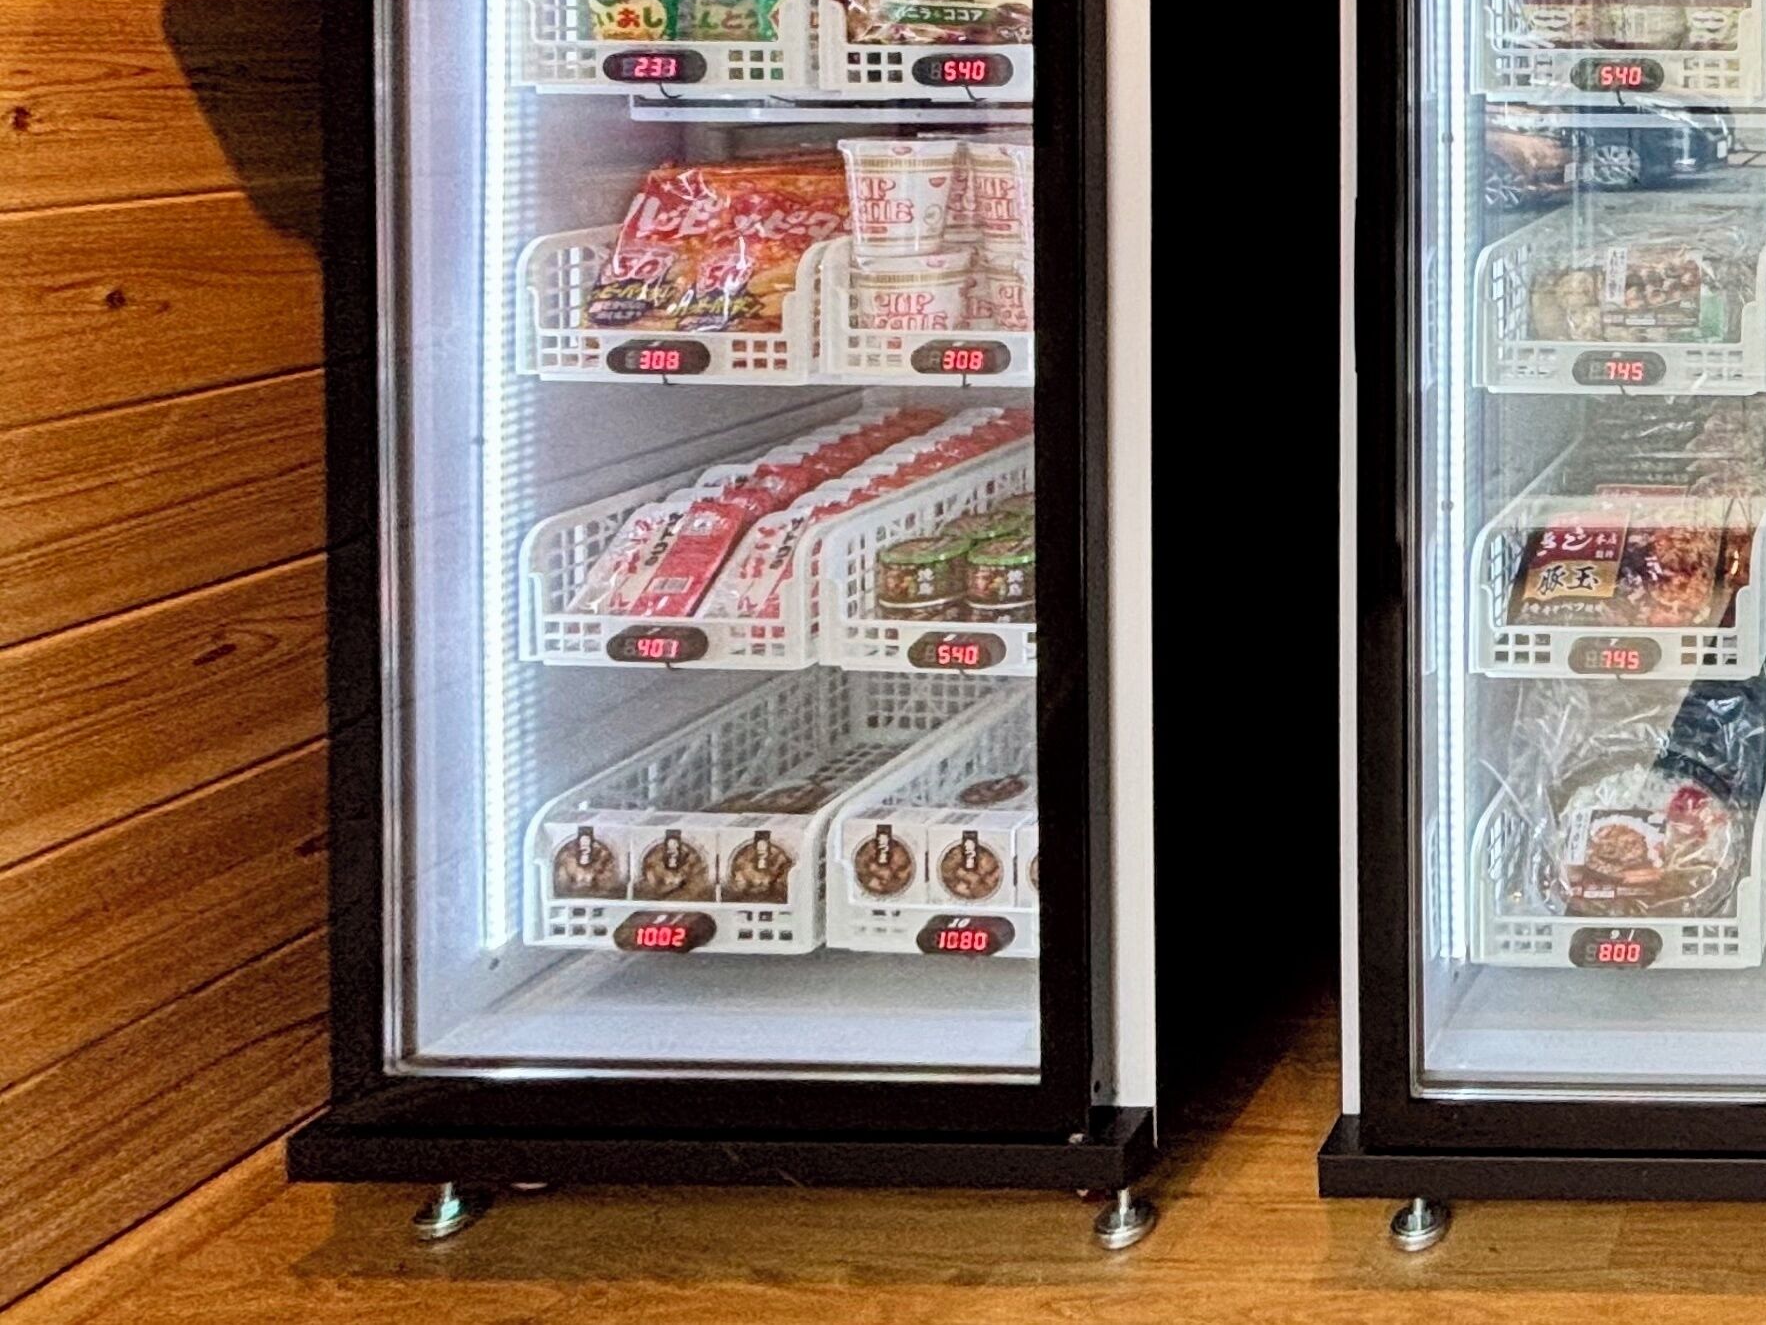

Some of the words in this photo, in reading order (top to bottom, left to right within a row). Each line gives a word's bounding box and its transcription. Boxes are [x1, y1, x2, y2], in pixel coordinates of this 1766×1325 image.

[944, 61, 986, 80] 540
[1600, 68, 1642, 86] 540
[640, 351, 680, 370] 308
[943, 351, 984, 370] 308
[1605, 362, 1643, 380] 745
[1536, 563, 1600, 595] 豚玉
[637, 639, 679, 658] 401
[938, 645, 979, 664] 540
[1601, 651, 1640, 669] 745
[636, 927, 686, 946] 1002
[939, 930, 988, 950] 1080
[1599, 943, 1641, 962] 800
